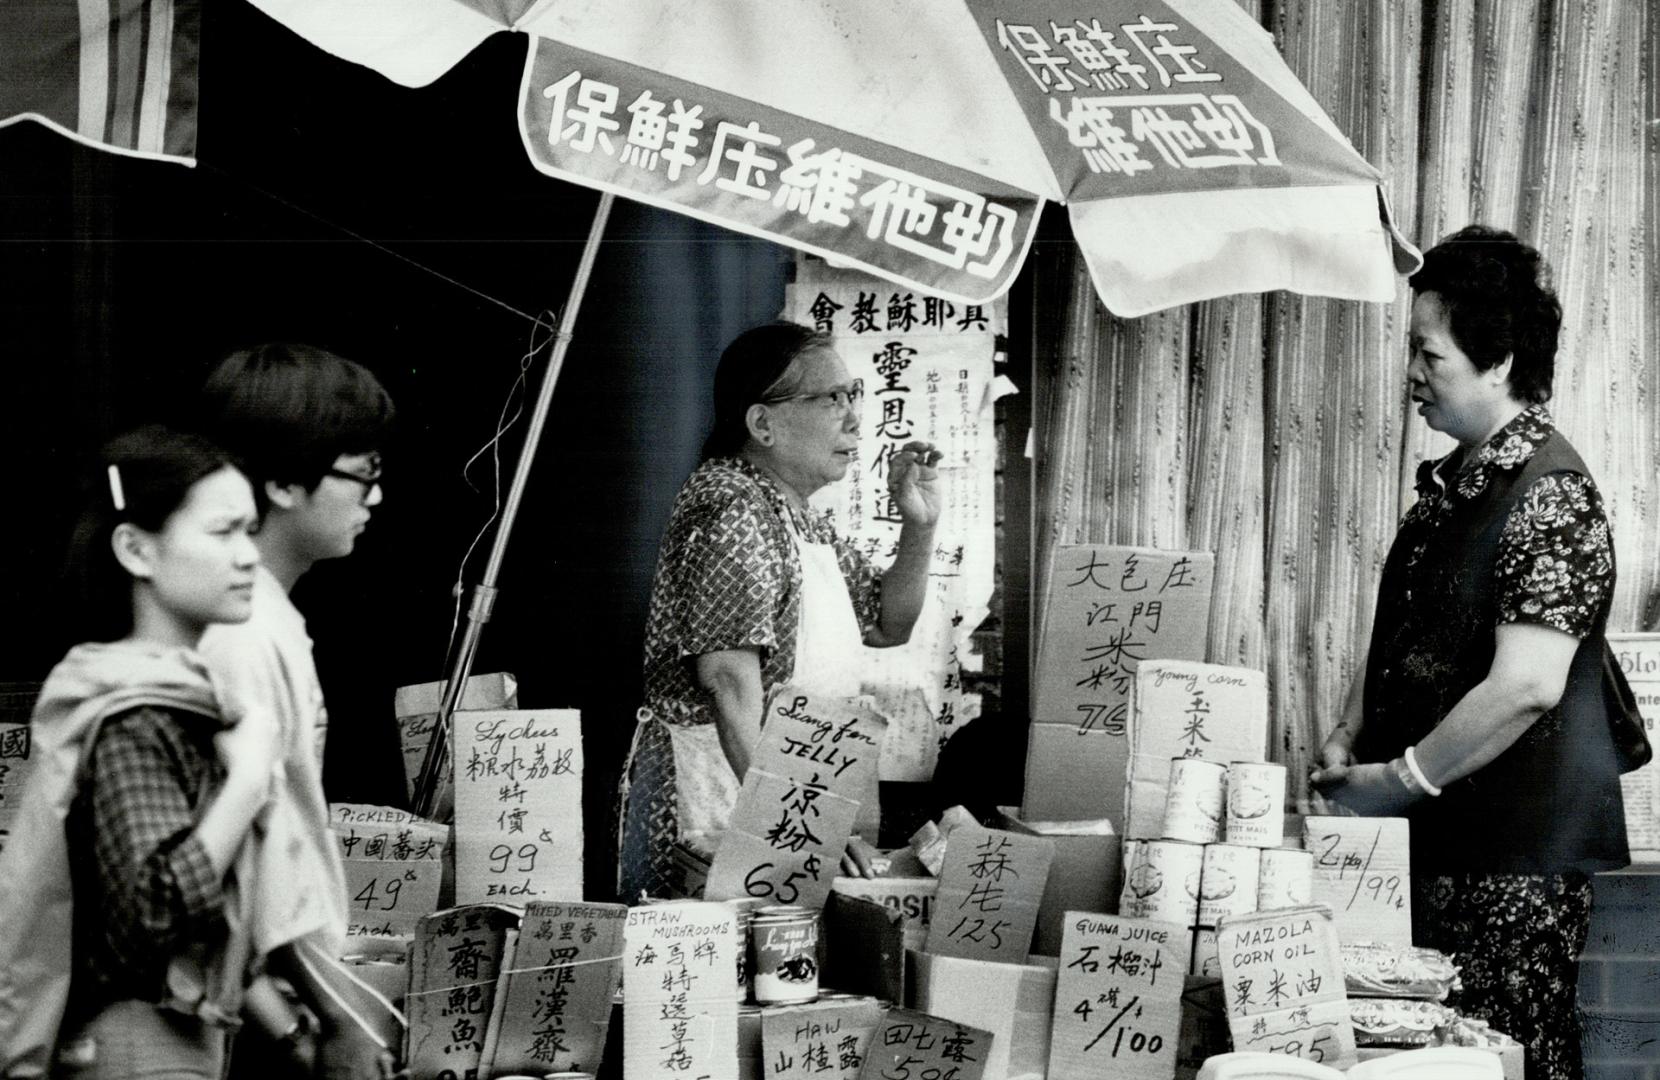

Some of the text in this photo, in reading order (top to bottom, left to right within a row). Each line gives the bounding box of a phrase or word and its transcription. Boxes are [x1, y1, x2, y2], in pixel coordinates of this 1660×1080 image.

[1086, 601, 1162, 633] 江門
[780, 737, 857, 778] JELLY
[628, 910, 682, 927] STRAW
[653, 921, 730, 939] MUSHROOMS
[1076, 919, 1169, 944] GUAVA JUICE
[1236, 920, 1314, 948] MAZOLA
[1233, 951, 1274, 969] CORN
[796, 1019, 840, 1043] HAW
